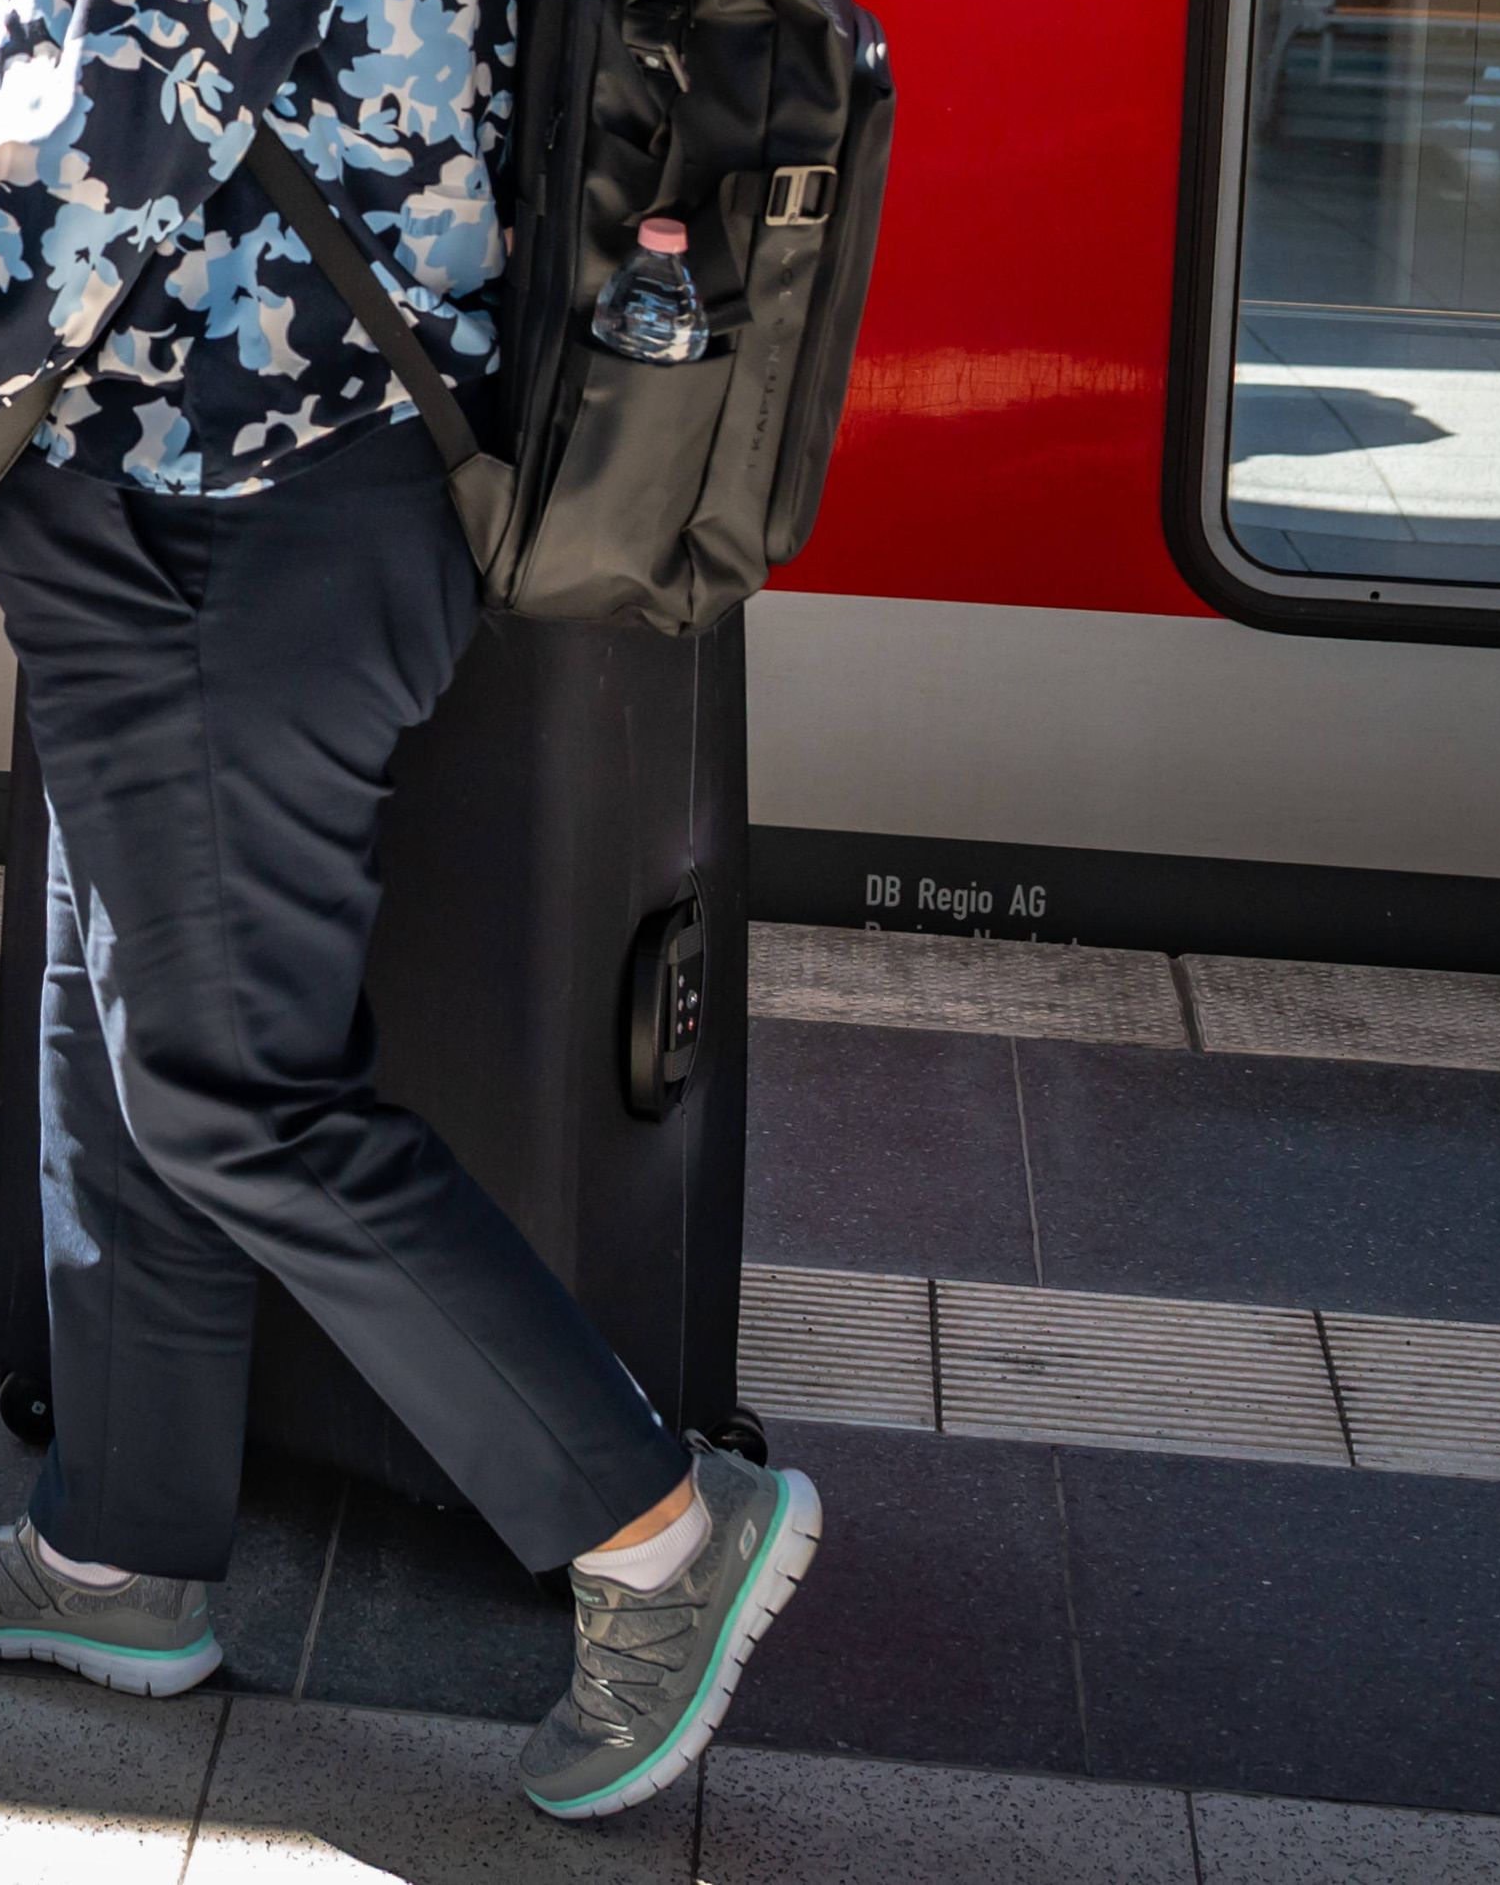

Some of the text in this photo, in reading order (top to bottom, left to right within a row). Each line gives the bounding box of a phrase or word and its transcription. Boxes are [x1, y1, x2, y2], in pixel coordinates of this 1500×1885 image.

[865, 873, 1047, 921] DB Regio AG
